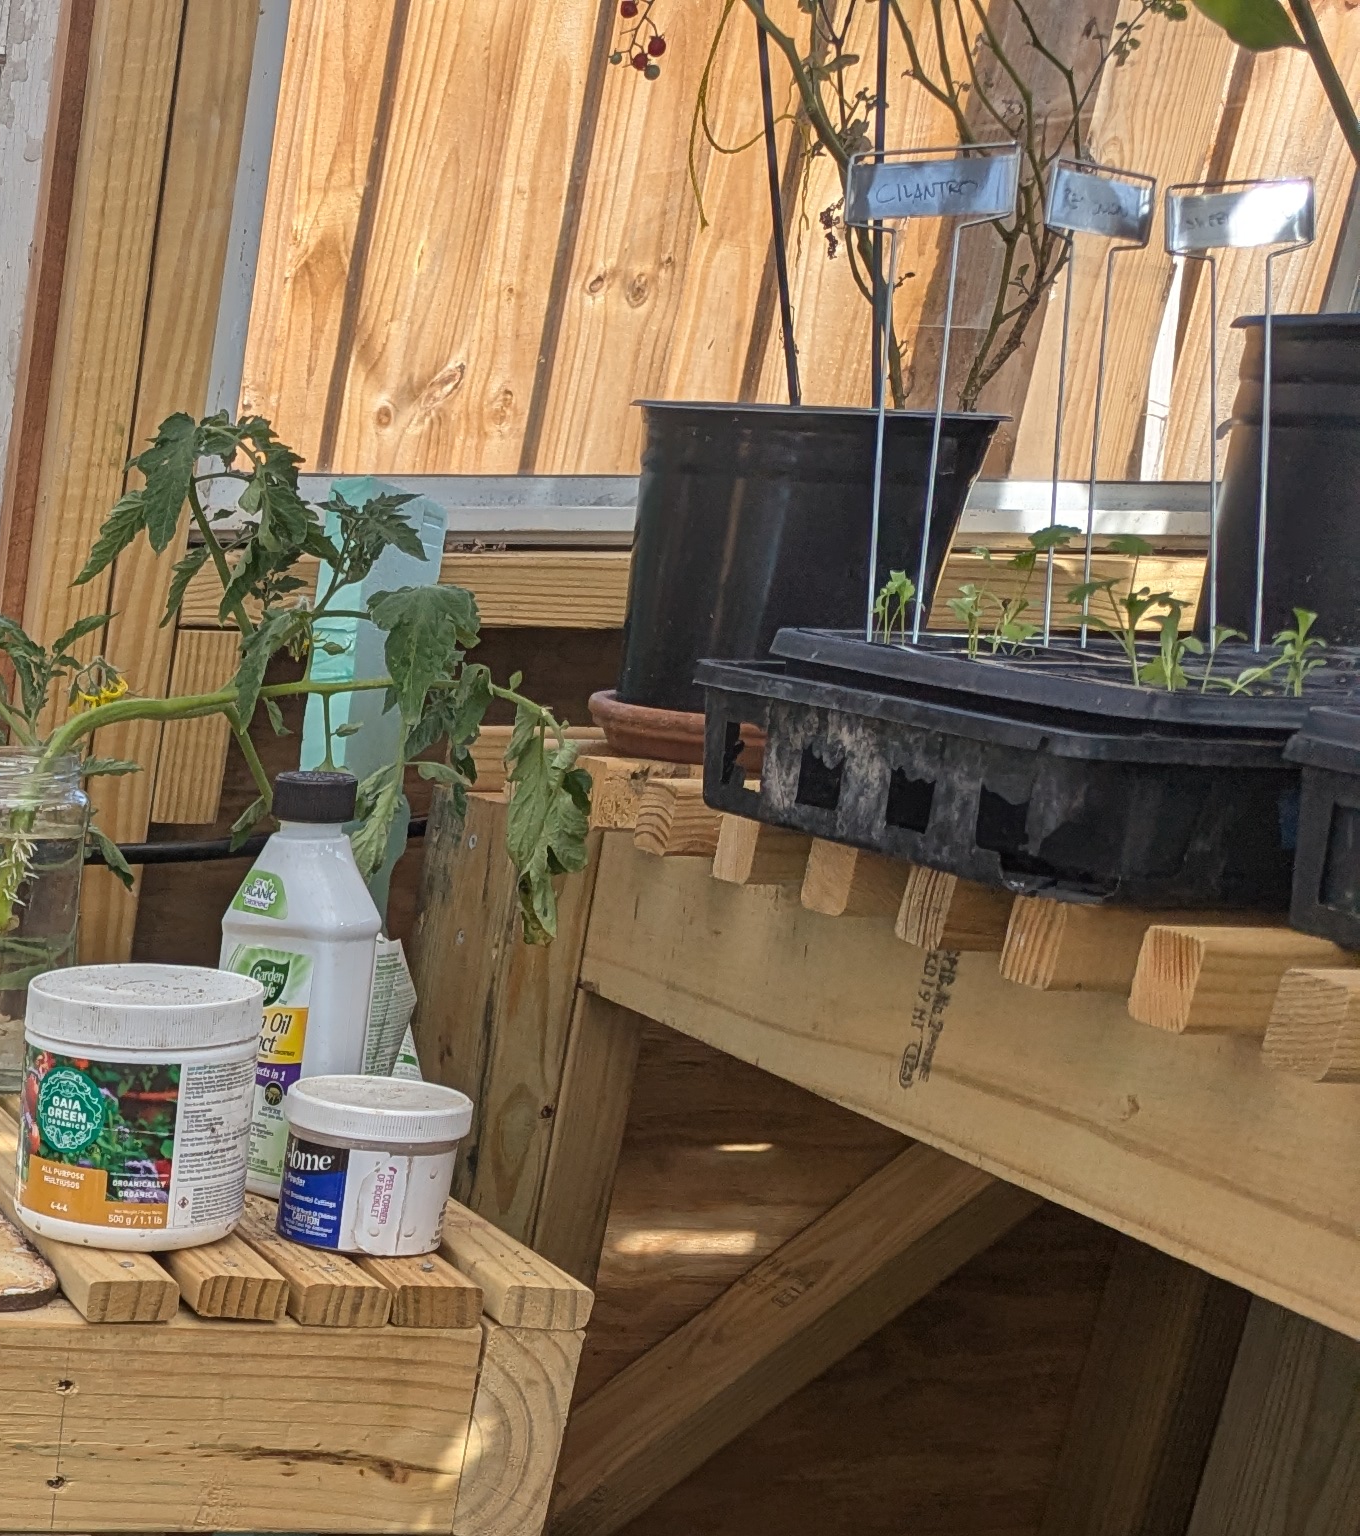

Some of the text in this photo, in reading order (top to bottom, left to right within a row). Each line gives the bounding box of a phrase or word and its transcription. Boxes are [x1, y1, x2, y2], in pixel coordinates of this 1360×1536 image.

[875, 180, 978, 204] CILANTRO
[252, 965, 285, 984] Garden
[270, 1012, 293, 1035] Oil
[52, 1095, 82, 1112] GAIA
[47, 1106, 87, 1124] GREEN
[47, 1118, 88, 1131] ORGANICS
[41, 1165, 85, 1181] ALL PURPOSE
[112, 1179, 166, 1188] ORGANICALLY
[370, 1173, 386, 1219] OF BOOKLET
[377, 1174, 395, 1226] PEEL CORNER
[108, 1214, 124, 1224] 500
[140, 1215, 152, 1225] 1.1
[153, 1215, 163, 1225] lb
[292, 1211, 320, 1226] CAUTION
